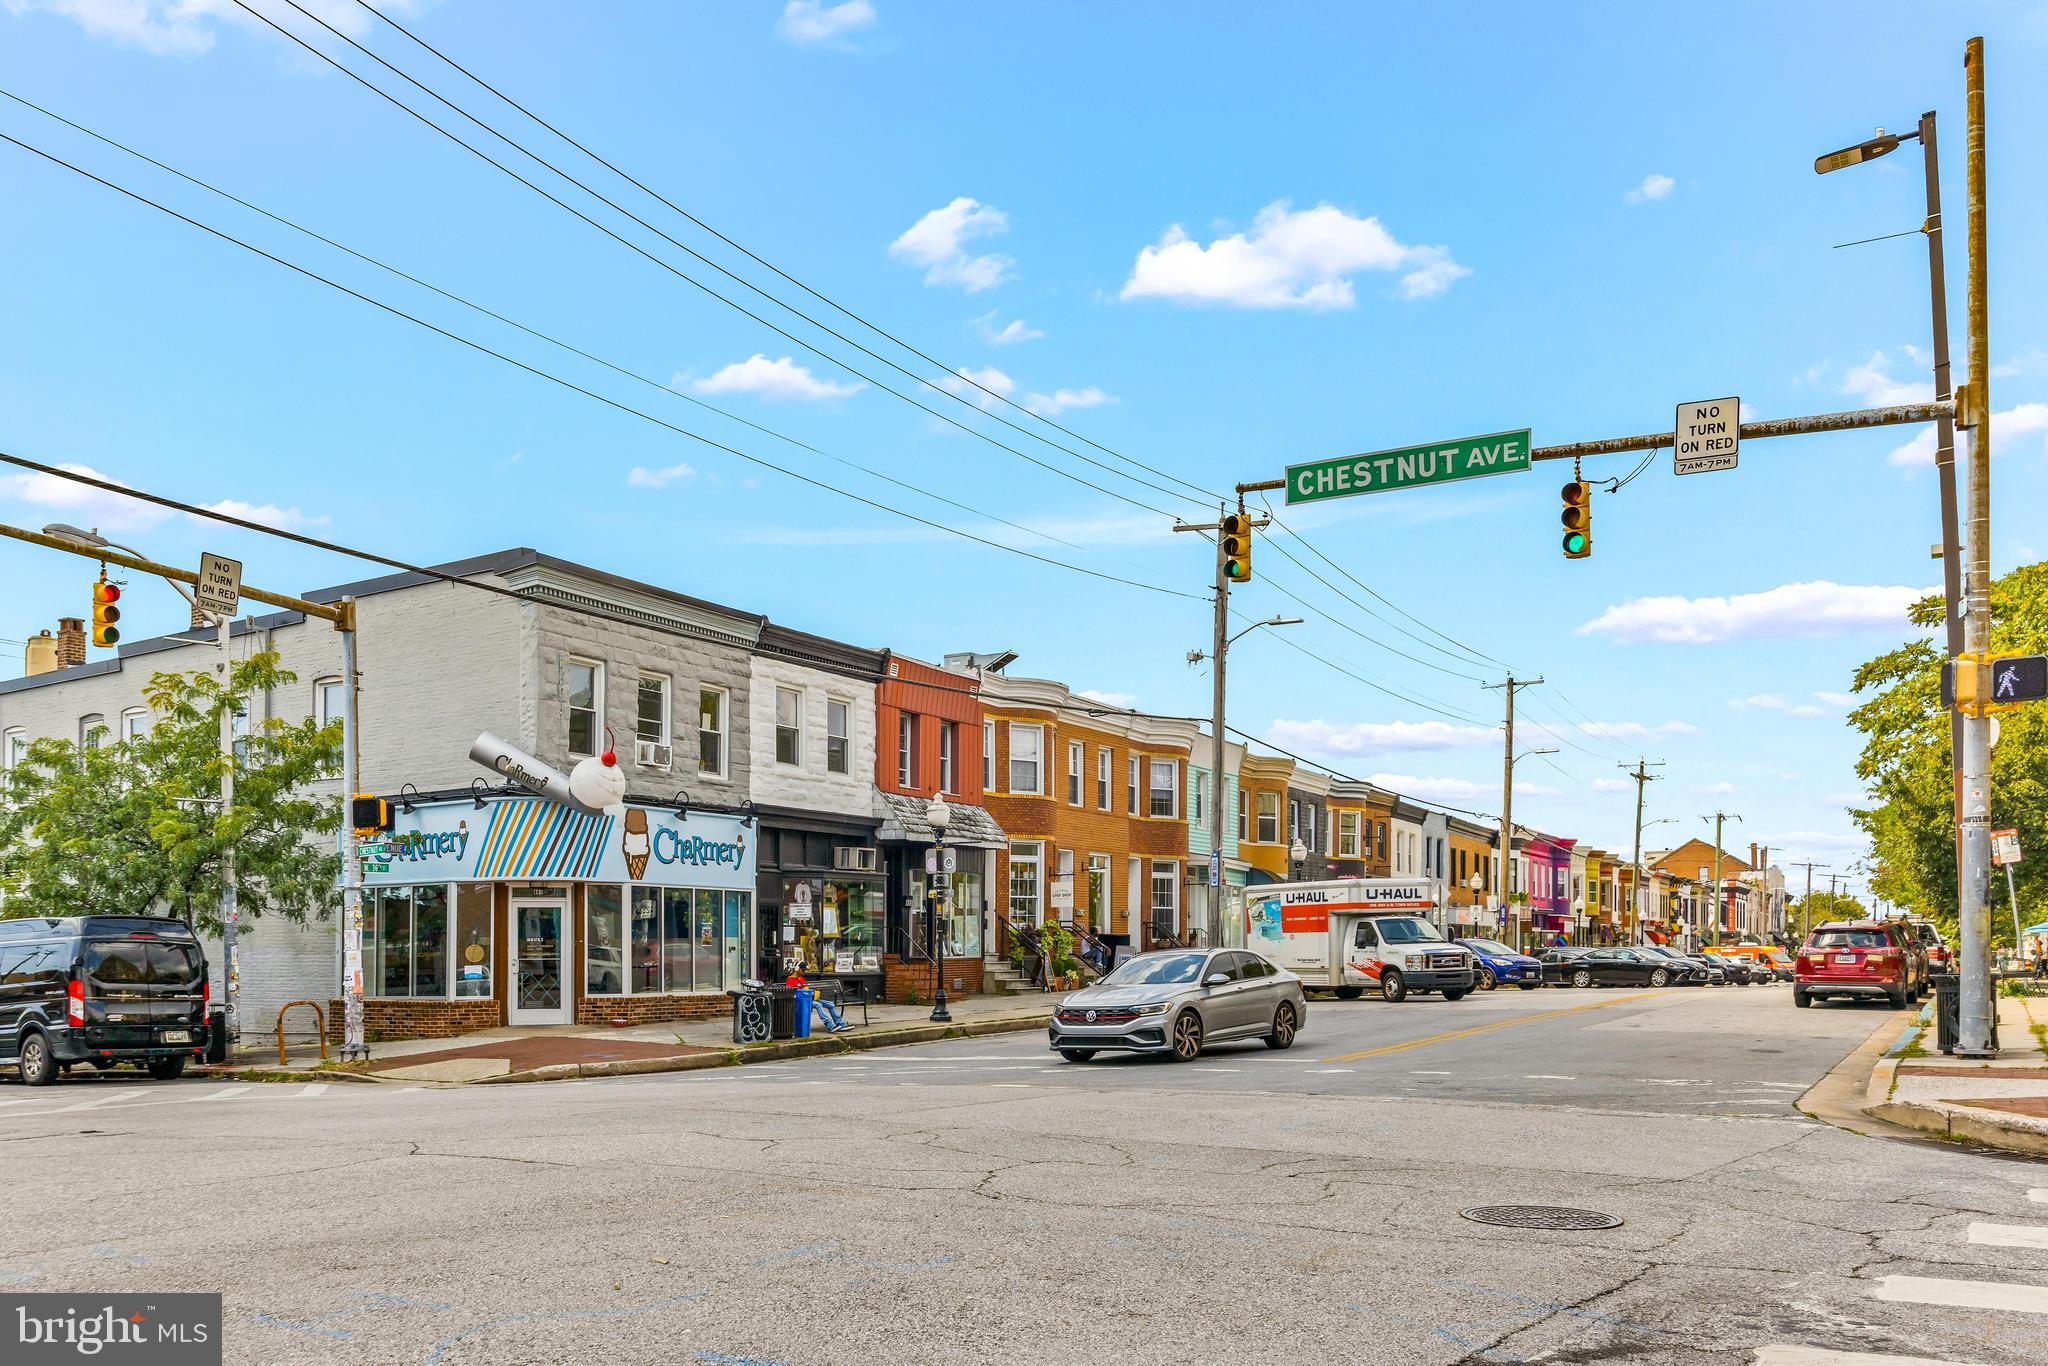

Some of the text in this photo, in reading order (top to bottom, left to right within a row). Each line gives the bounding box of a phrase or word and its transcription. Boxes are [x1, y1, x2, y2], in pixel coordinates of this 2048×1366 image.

[1696, 406, 1720, 419] NO
[1689, 422, 1726, 437] TURN
[1681, 437, 1734, 453] ON RED
[1297, 441, 1526, 496] CHESTNUT AVE.
[1680, 458, 1731, 473] 7AM-7PM
[214, 561, 230, 573] NO
[209, 572, 233, 587] TURN
[202, 584, 236, 600] ON RED
[200, 600, 233, 612] 7AM-7PM
[359, 845, 379, 856] CHESTNUT
[373, 829, 470, 862] Rmery
[1286, 891, 1329, 904] U-HAUL
[1366, 888, 1422, 899] U-HAUL
